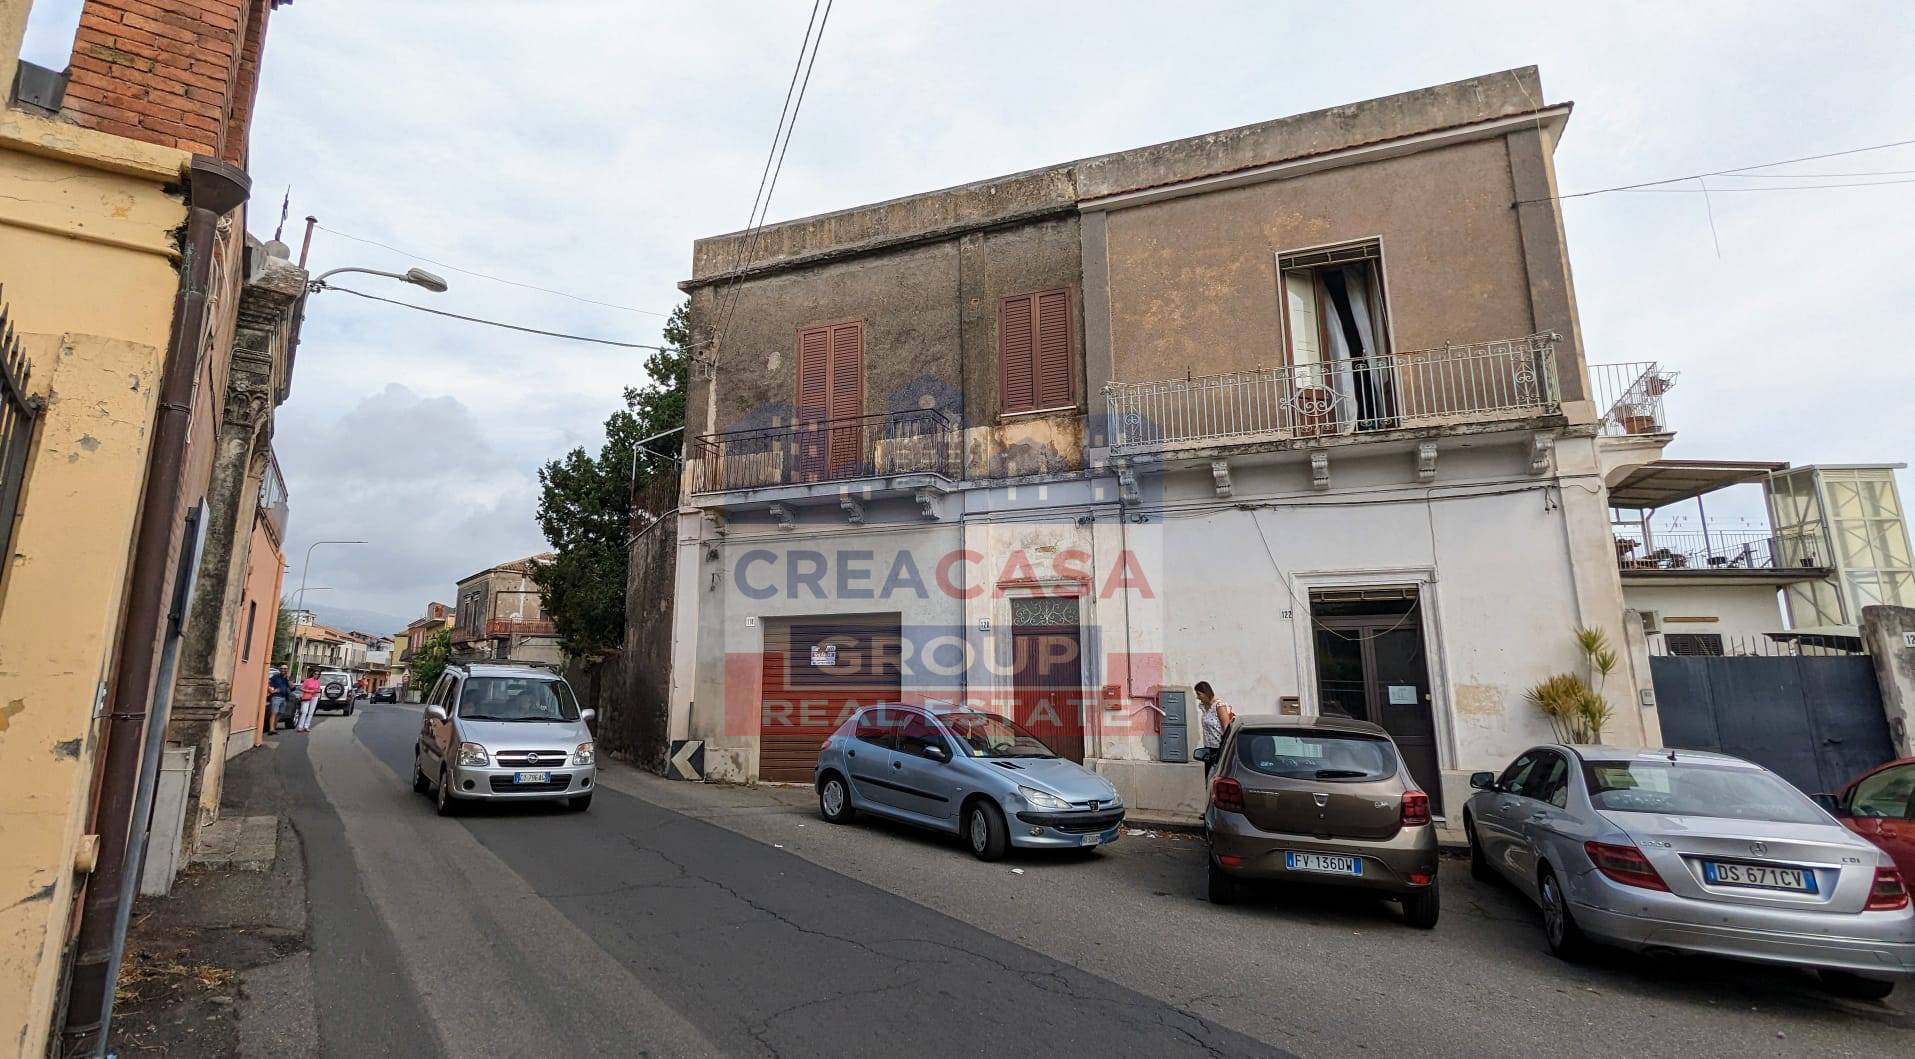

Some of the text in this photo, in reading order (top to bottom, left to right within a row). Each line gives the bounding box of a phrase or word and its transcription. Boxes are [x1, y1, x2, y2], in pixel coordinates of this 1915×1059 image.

[1281, 610, 1293, 619] 122
[1295, 854, 1353, 871] FV 136DW
[1717, 864, 1801, 887] DS 671CV
